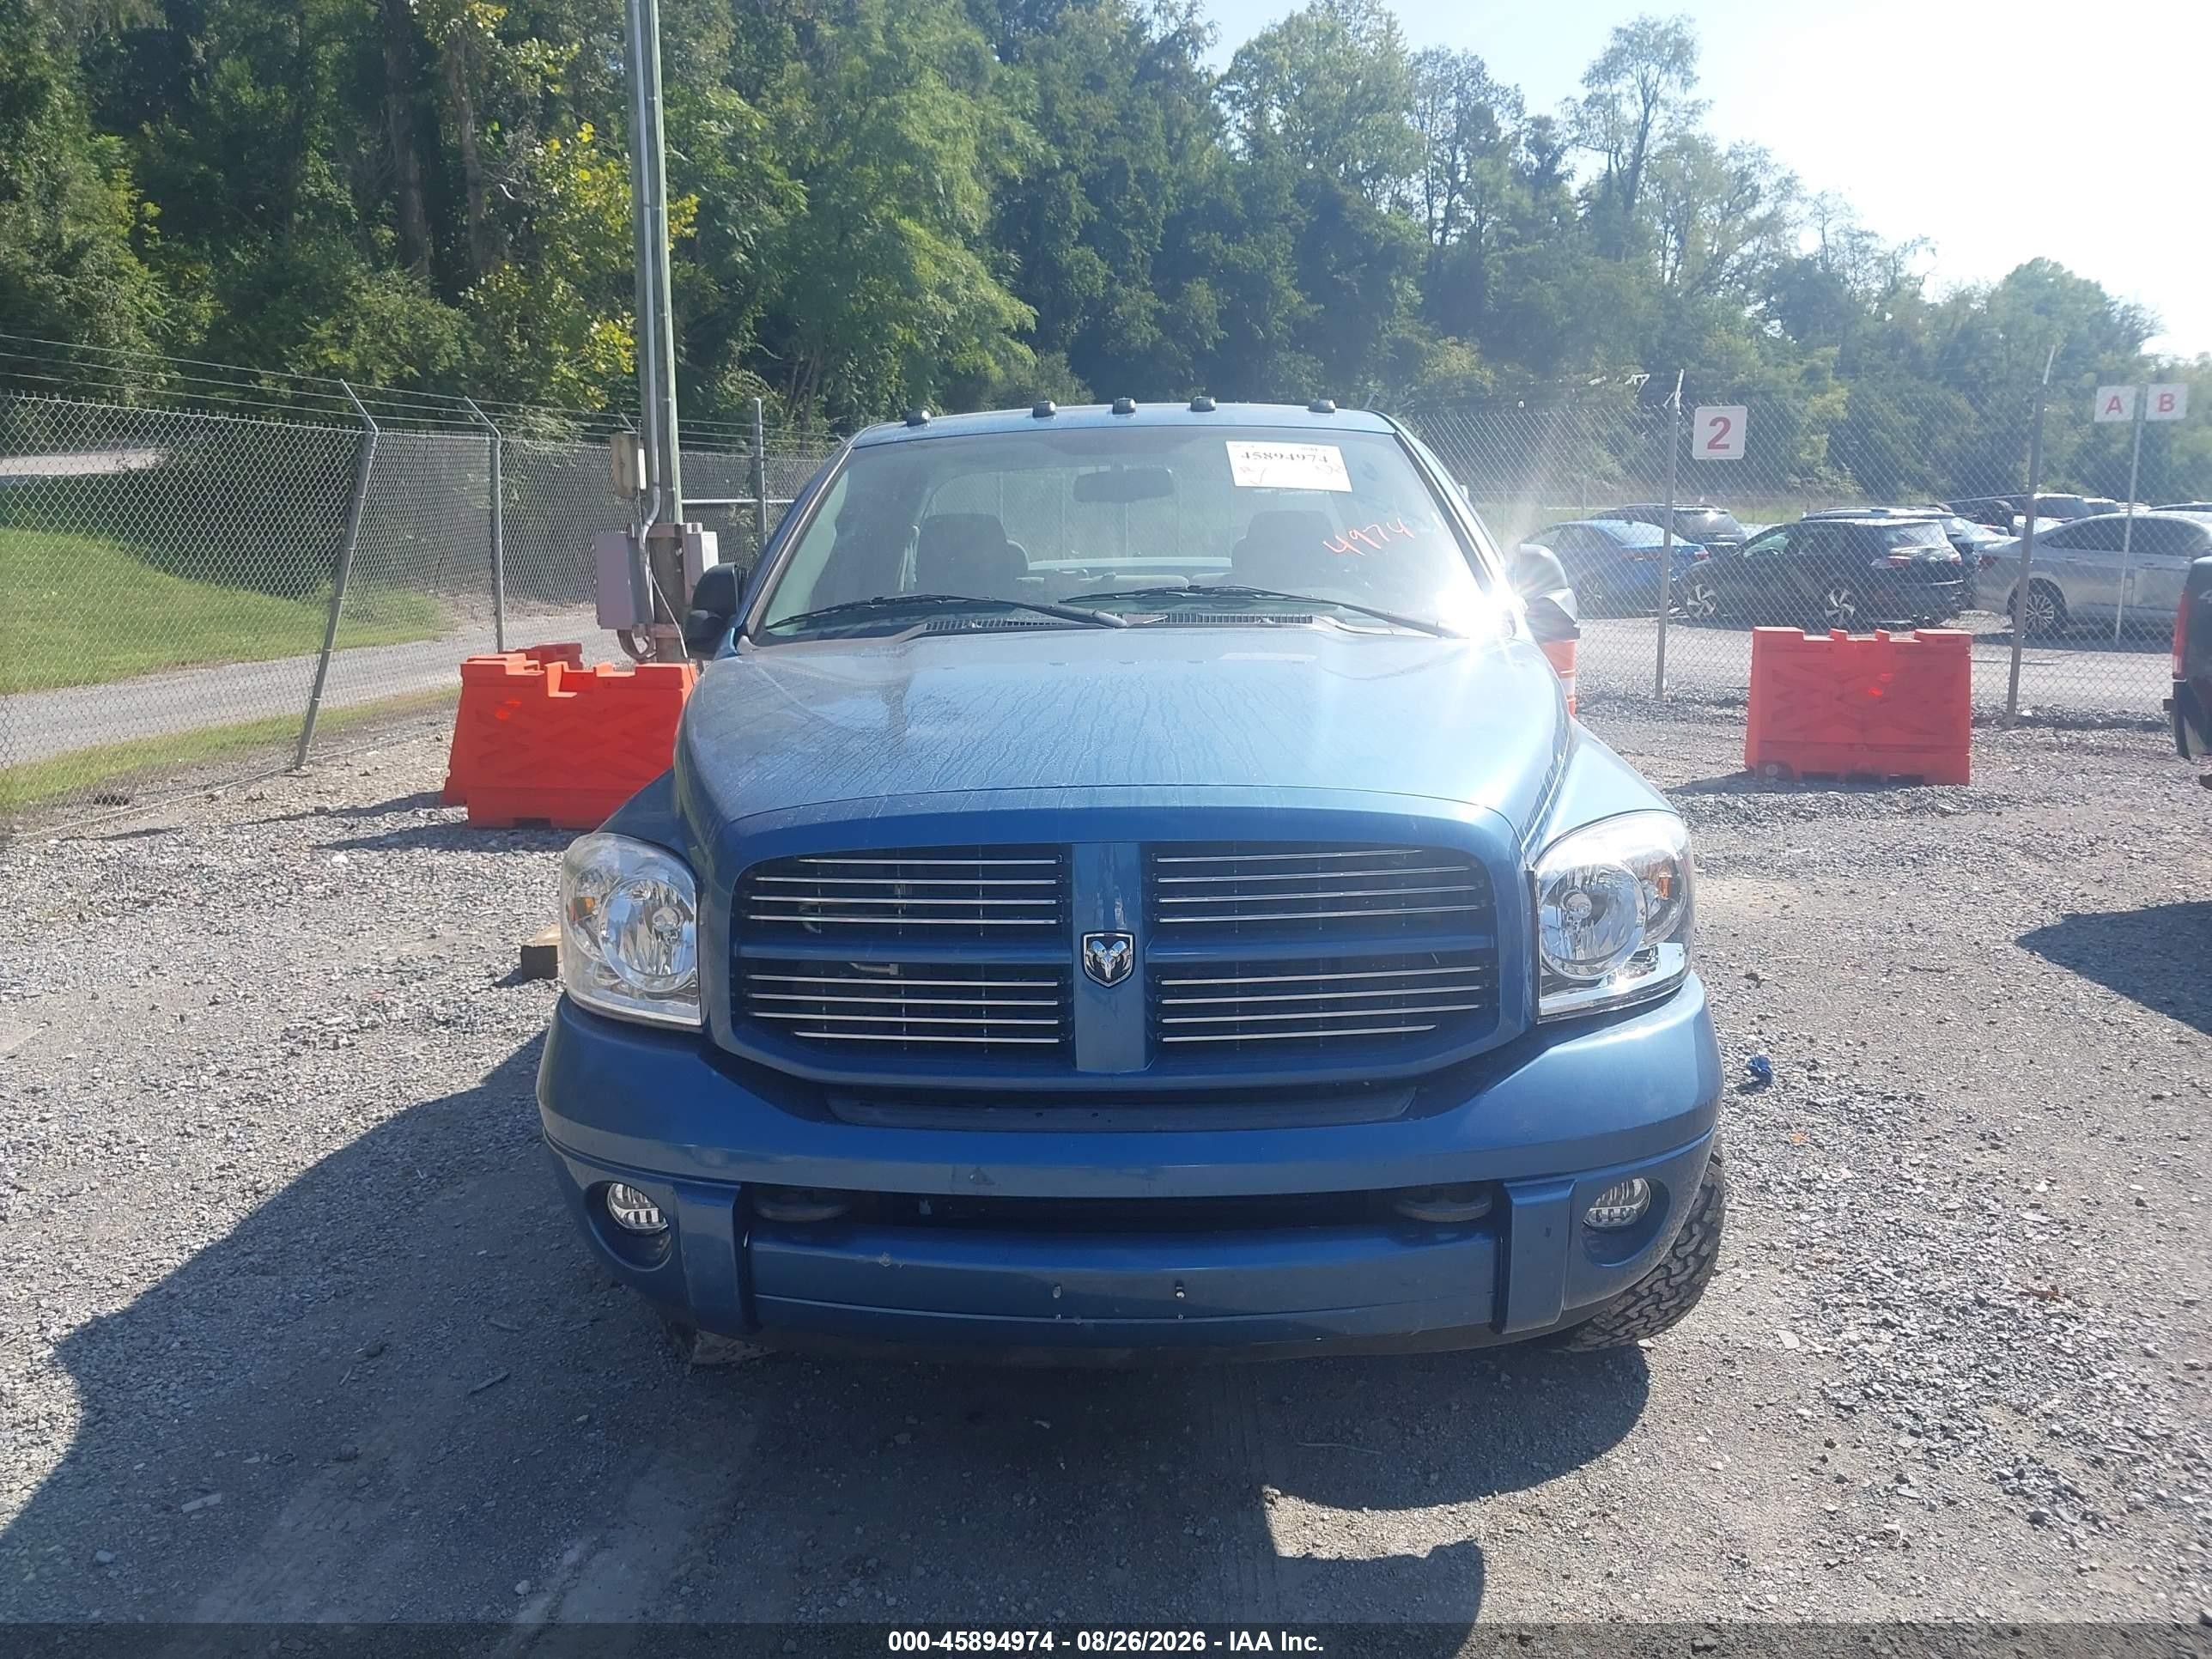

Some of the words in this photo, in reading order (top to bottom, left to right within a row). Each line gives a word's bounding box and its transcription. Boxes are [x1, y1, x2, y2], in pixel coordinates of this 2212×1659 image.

[2106, 395, 2123, 415] A
[2158, 393, 2175, 412] B
[1707, 416, 1731, 449] 2
[1240, 452, 1328, 464] 45894974
[1322, 517, 1416, 556] 4974
